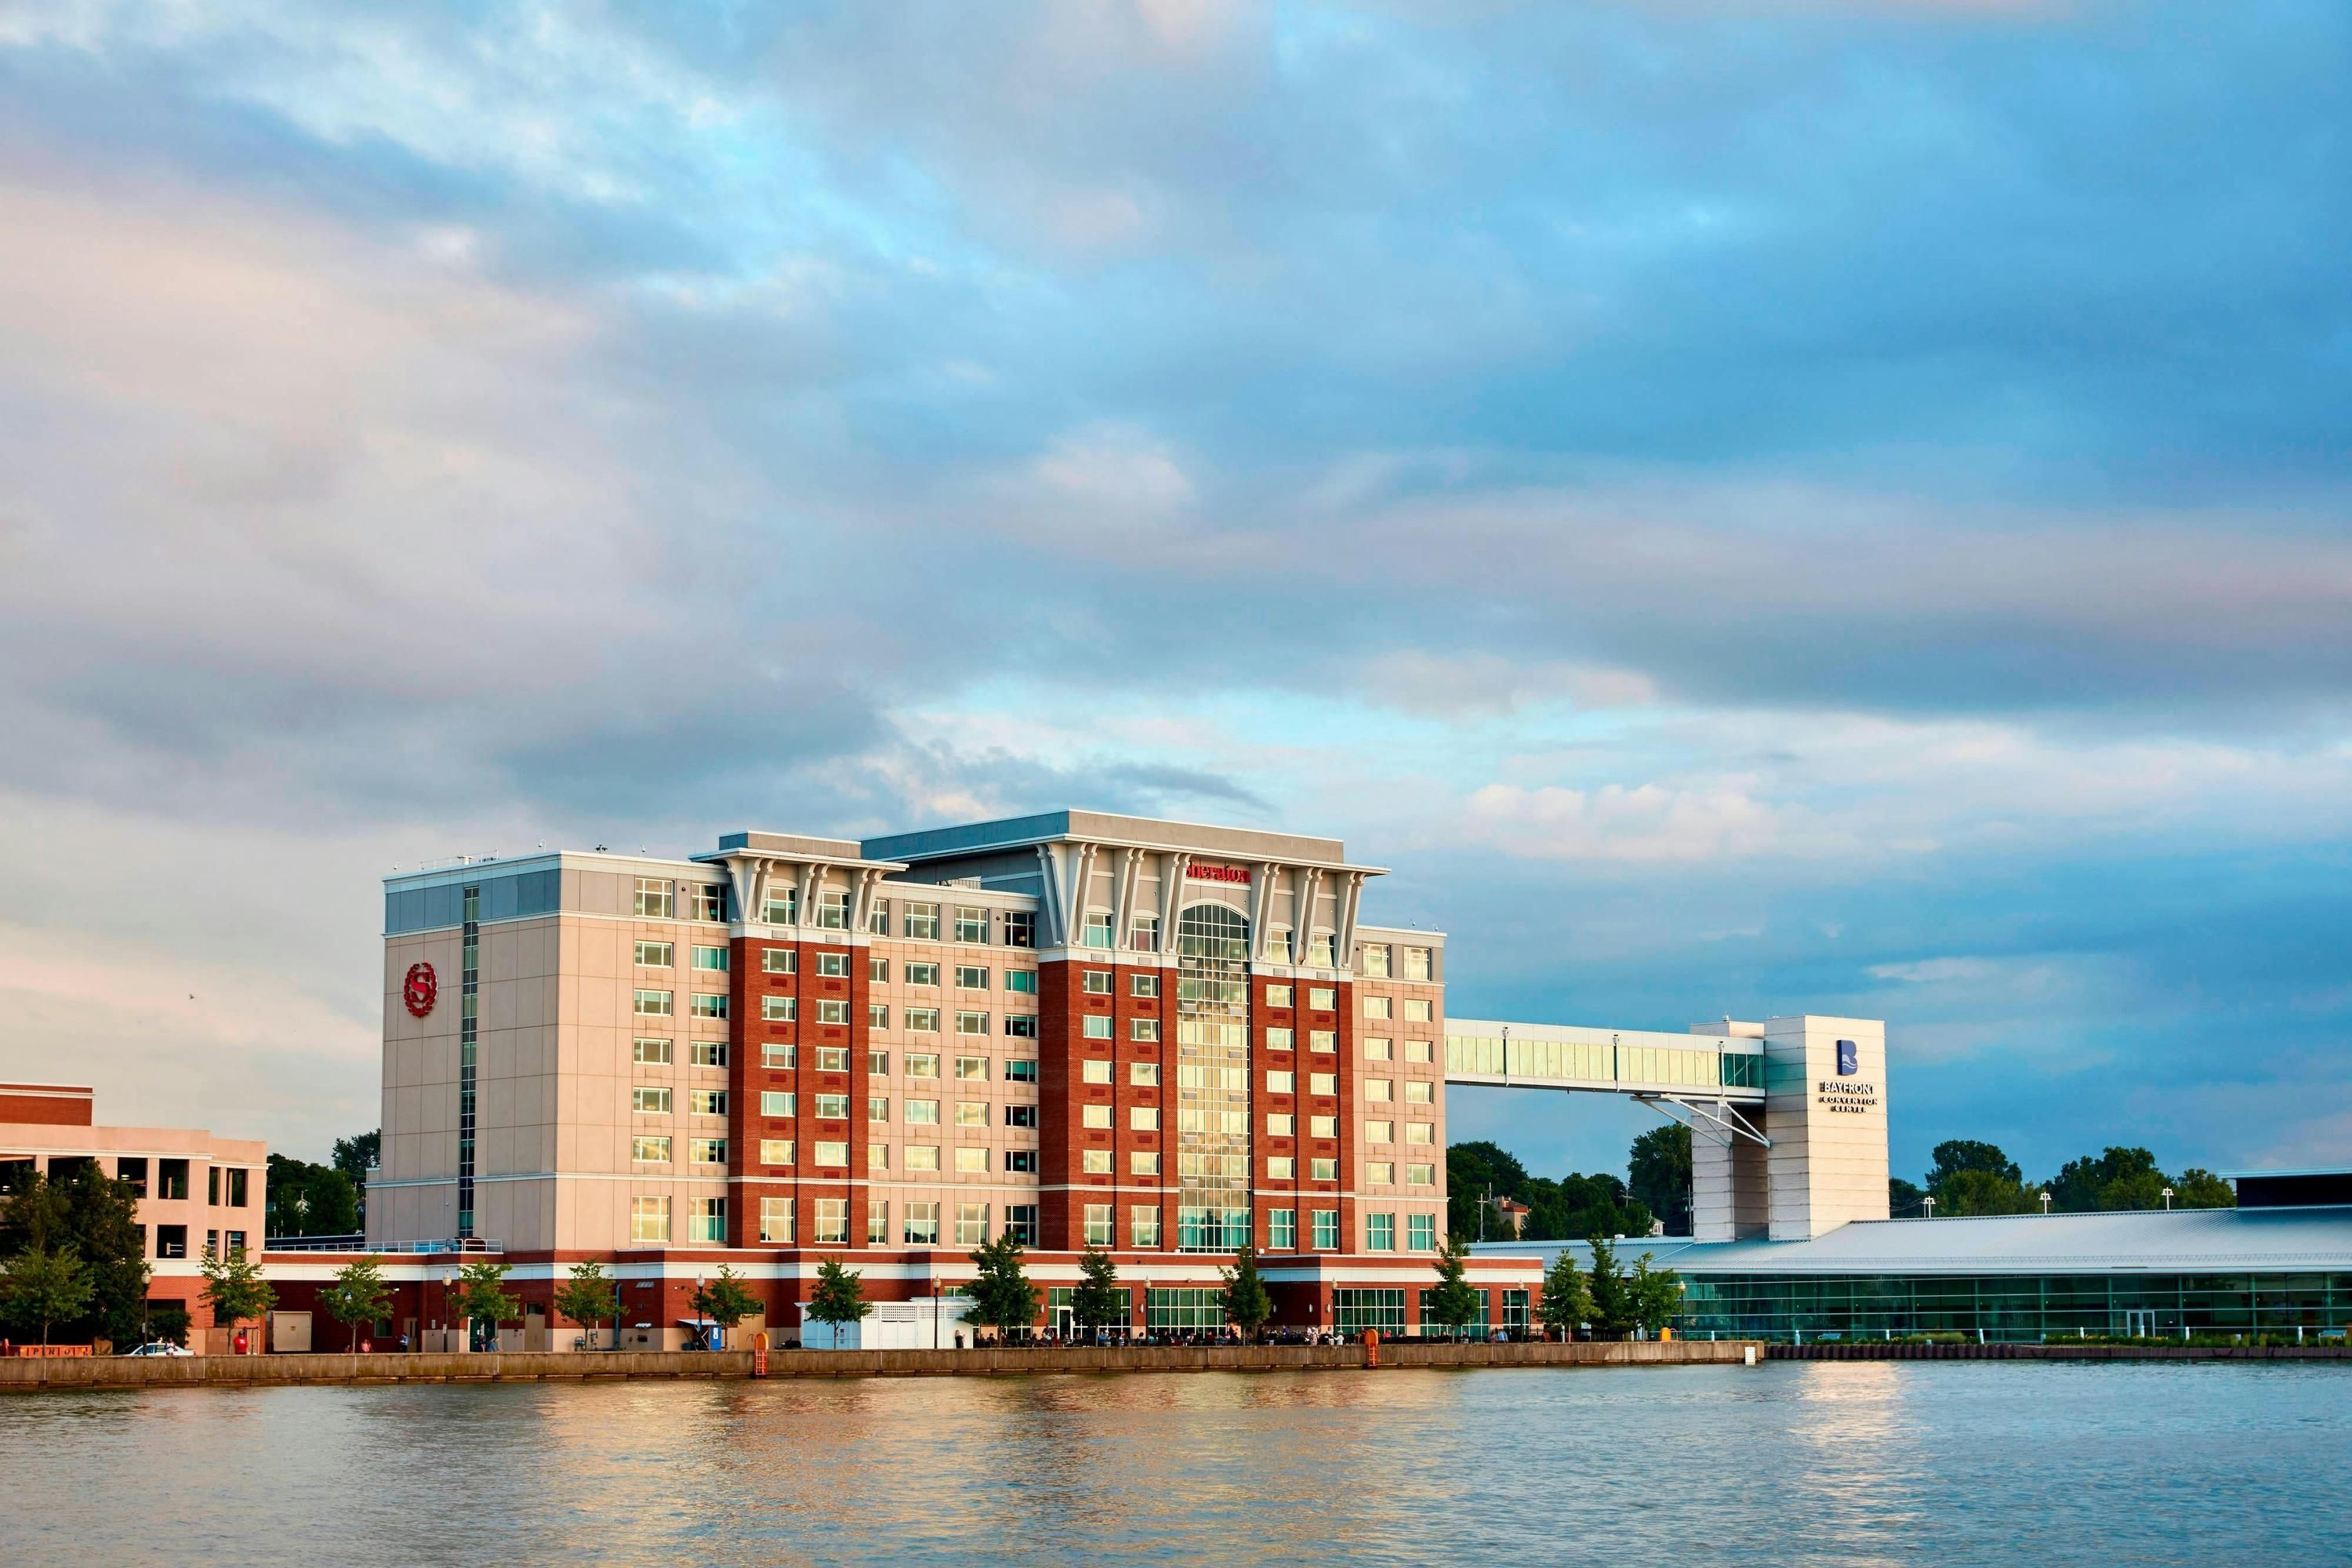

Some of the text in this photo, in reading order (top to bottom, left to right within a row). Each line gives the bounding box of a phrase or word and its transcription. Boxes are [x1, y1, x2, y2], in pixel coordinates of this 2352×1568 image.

[1836, 1040, 1857, 1076] B
[1820, 1081, 1874, 1094] BAYFRONT
[1819, 1096, 1878, 1105] CONVENTION
